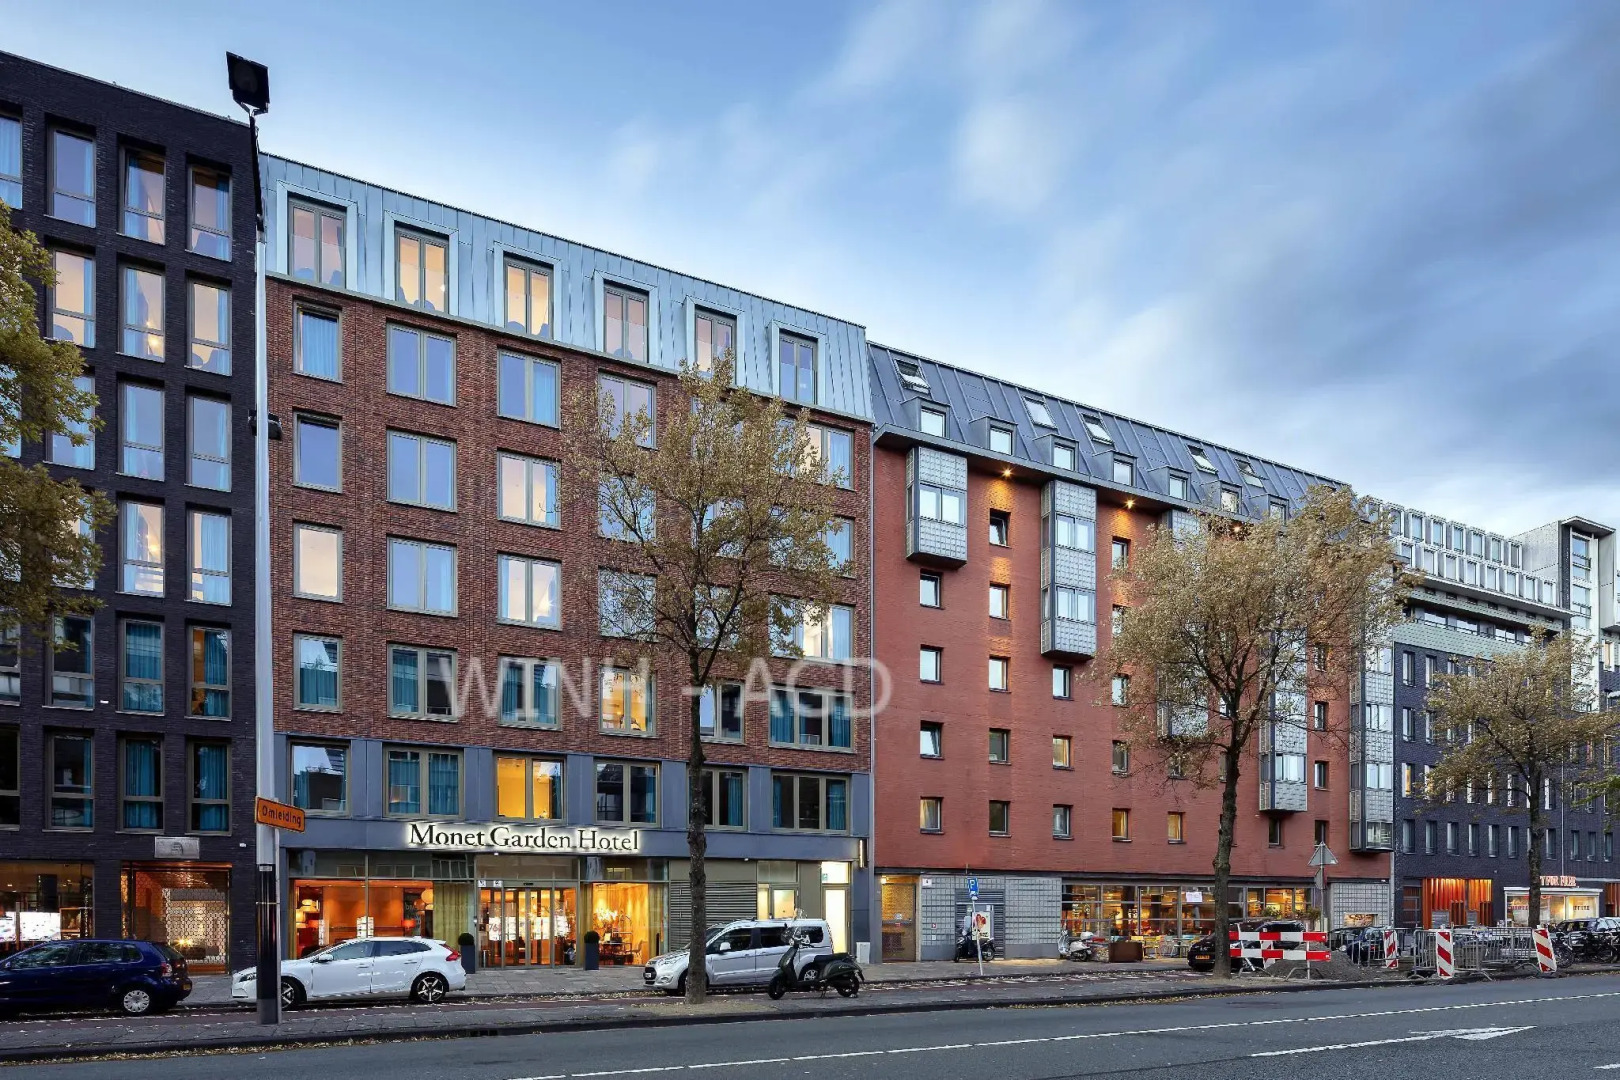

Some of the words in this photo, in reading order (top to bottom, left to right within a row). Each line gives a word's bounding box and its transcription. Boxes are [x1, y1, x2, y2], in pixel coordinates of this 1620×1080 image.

[262, 805, 301, 827] Omleiding
[409, 823, 485, 846] Monet
[490, 826, 572, 848] Garden
[577, 829, 639, 850] Hotel
